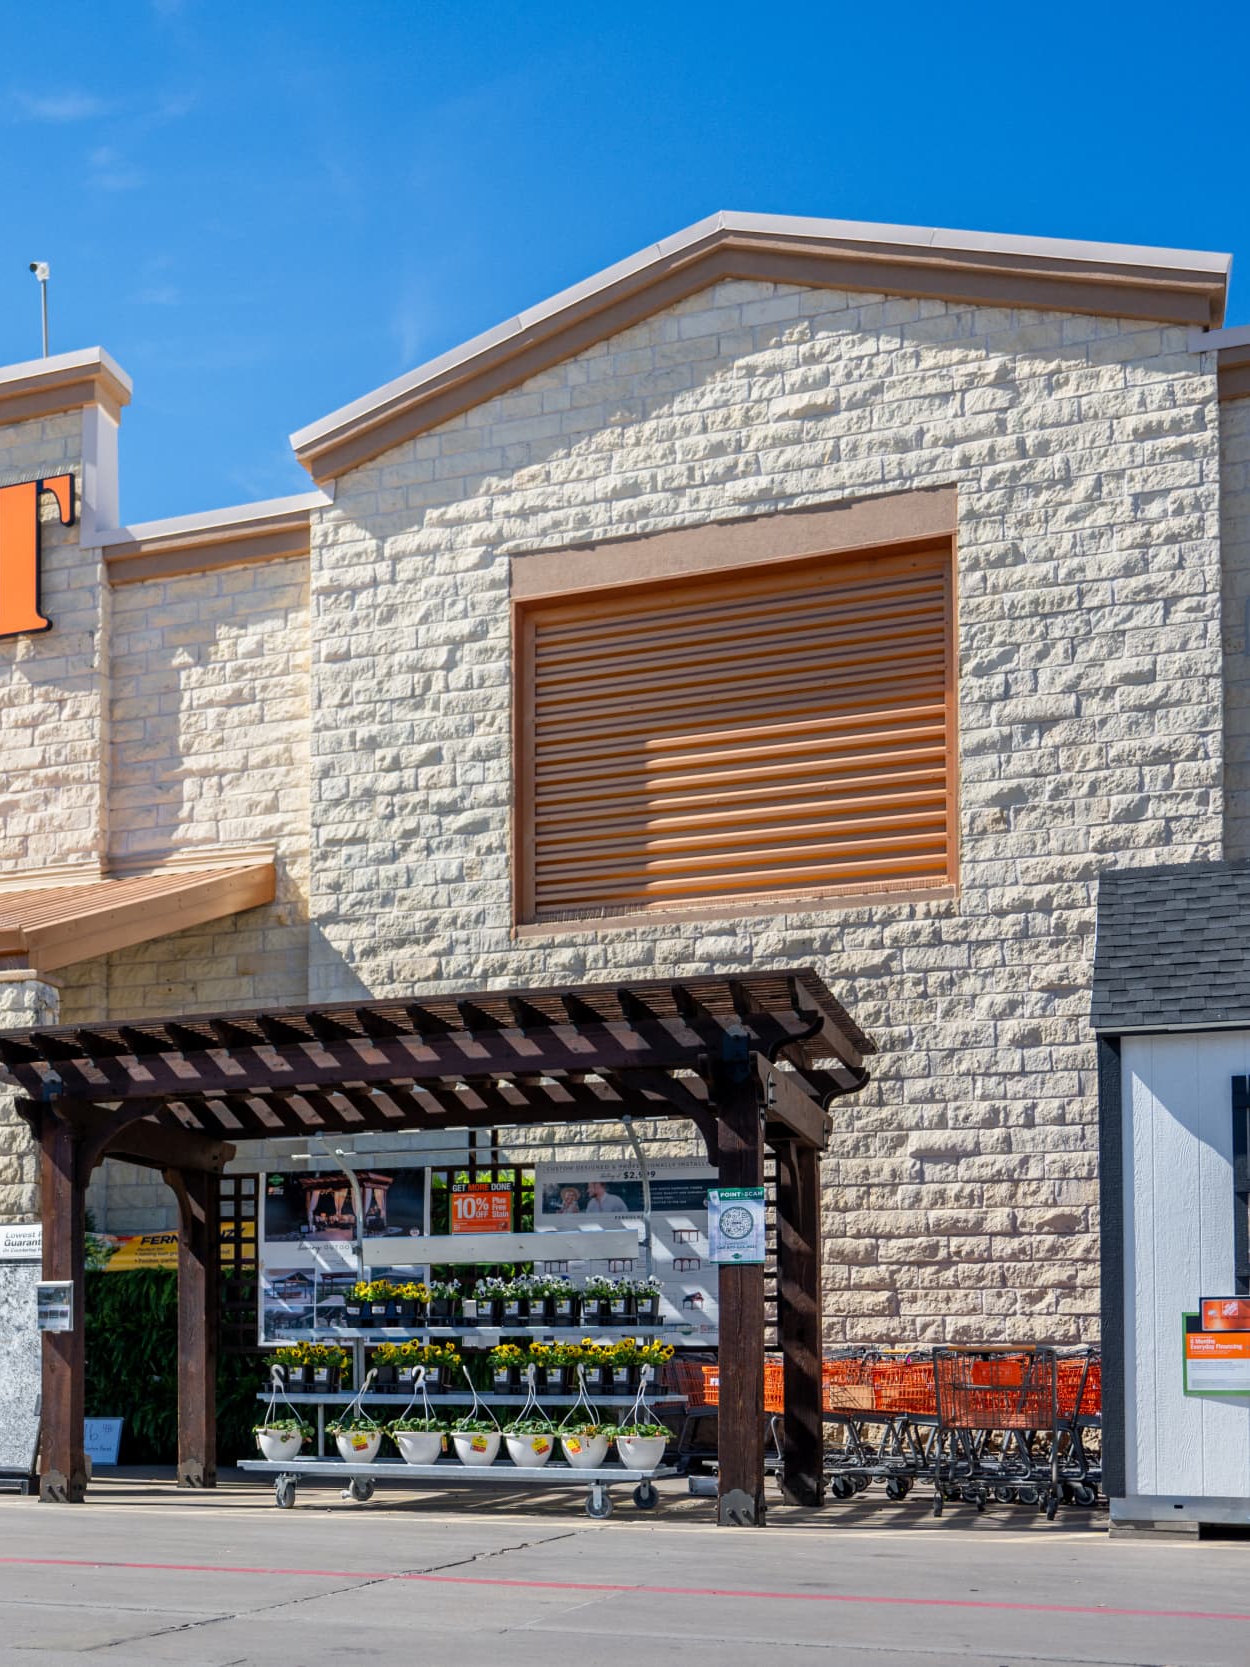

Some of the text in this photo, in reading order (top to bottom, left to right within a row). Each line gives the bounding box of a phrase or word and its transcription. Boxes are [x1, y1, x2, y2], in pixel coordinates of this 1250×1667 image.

[452, 1182, 511, 1192] GET MORE DONE
[454, 1197, 489, 1219] 10% OFF
[5, 1231, 36, 1239] Lowest
[4, 1238, 42, 1247] Guarant
